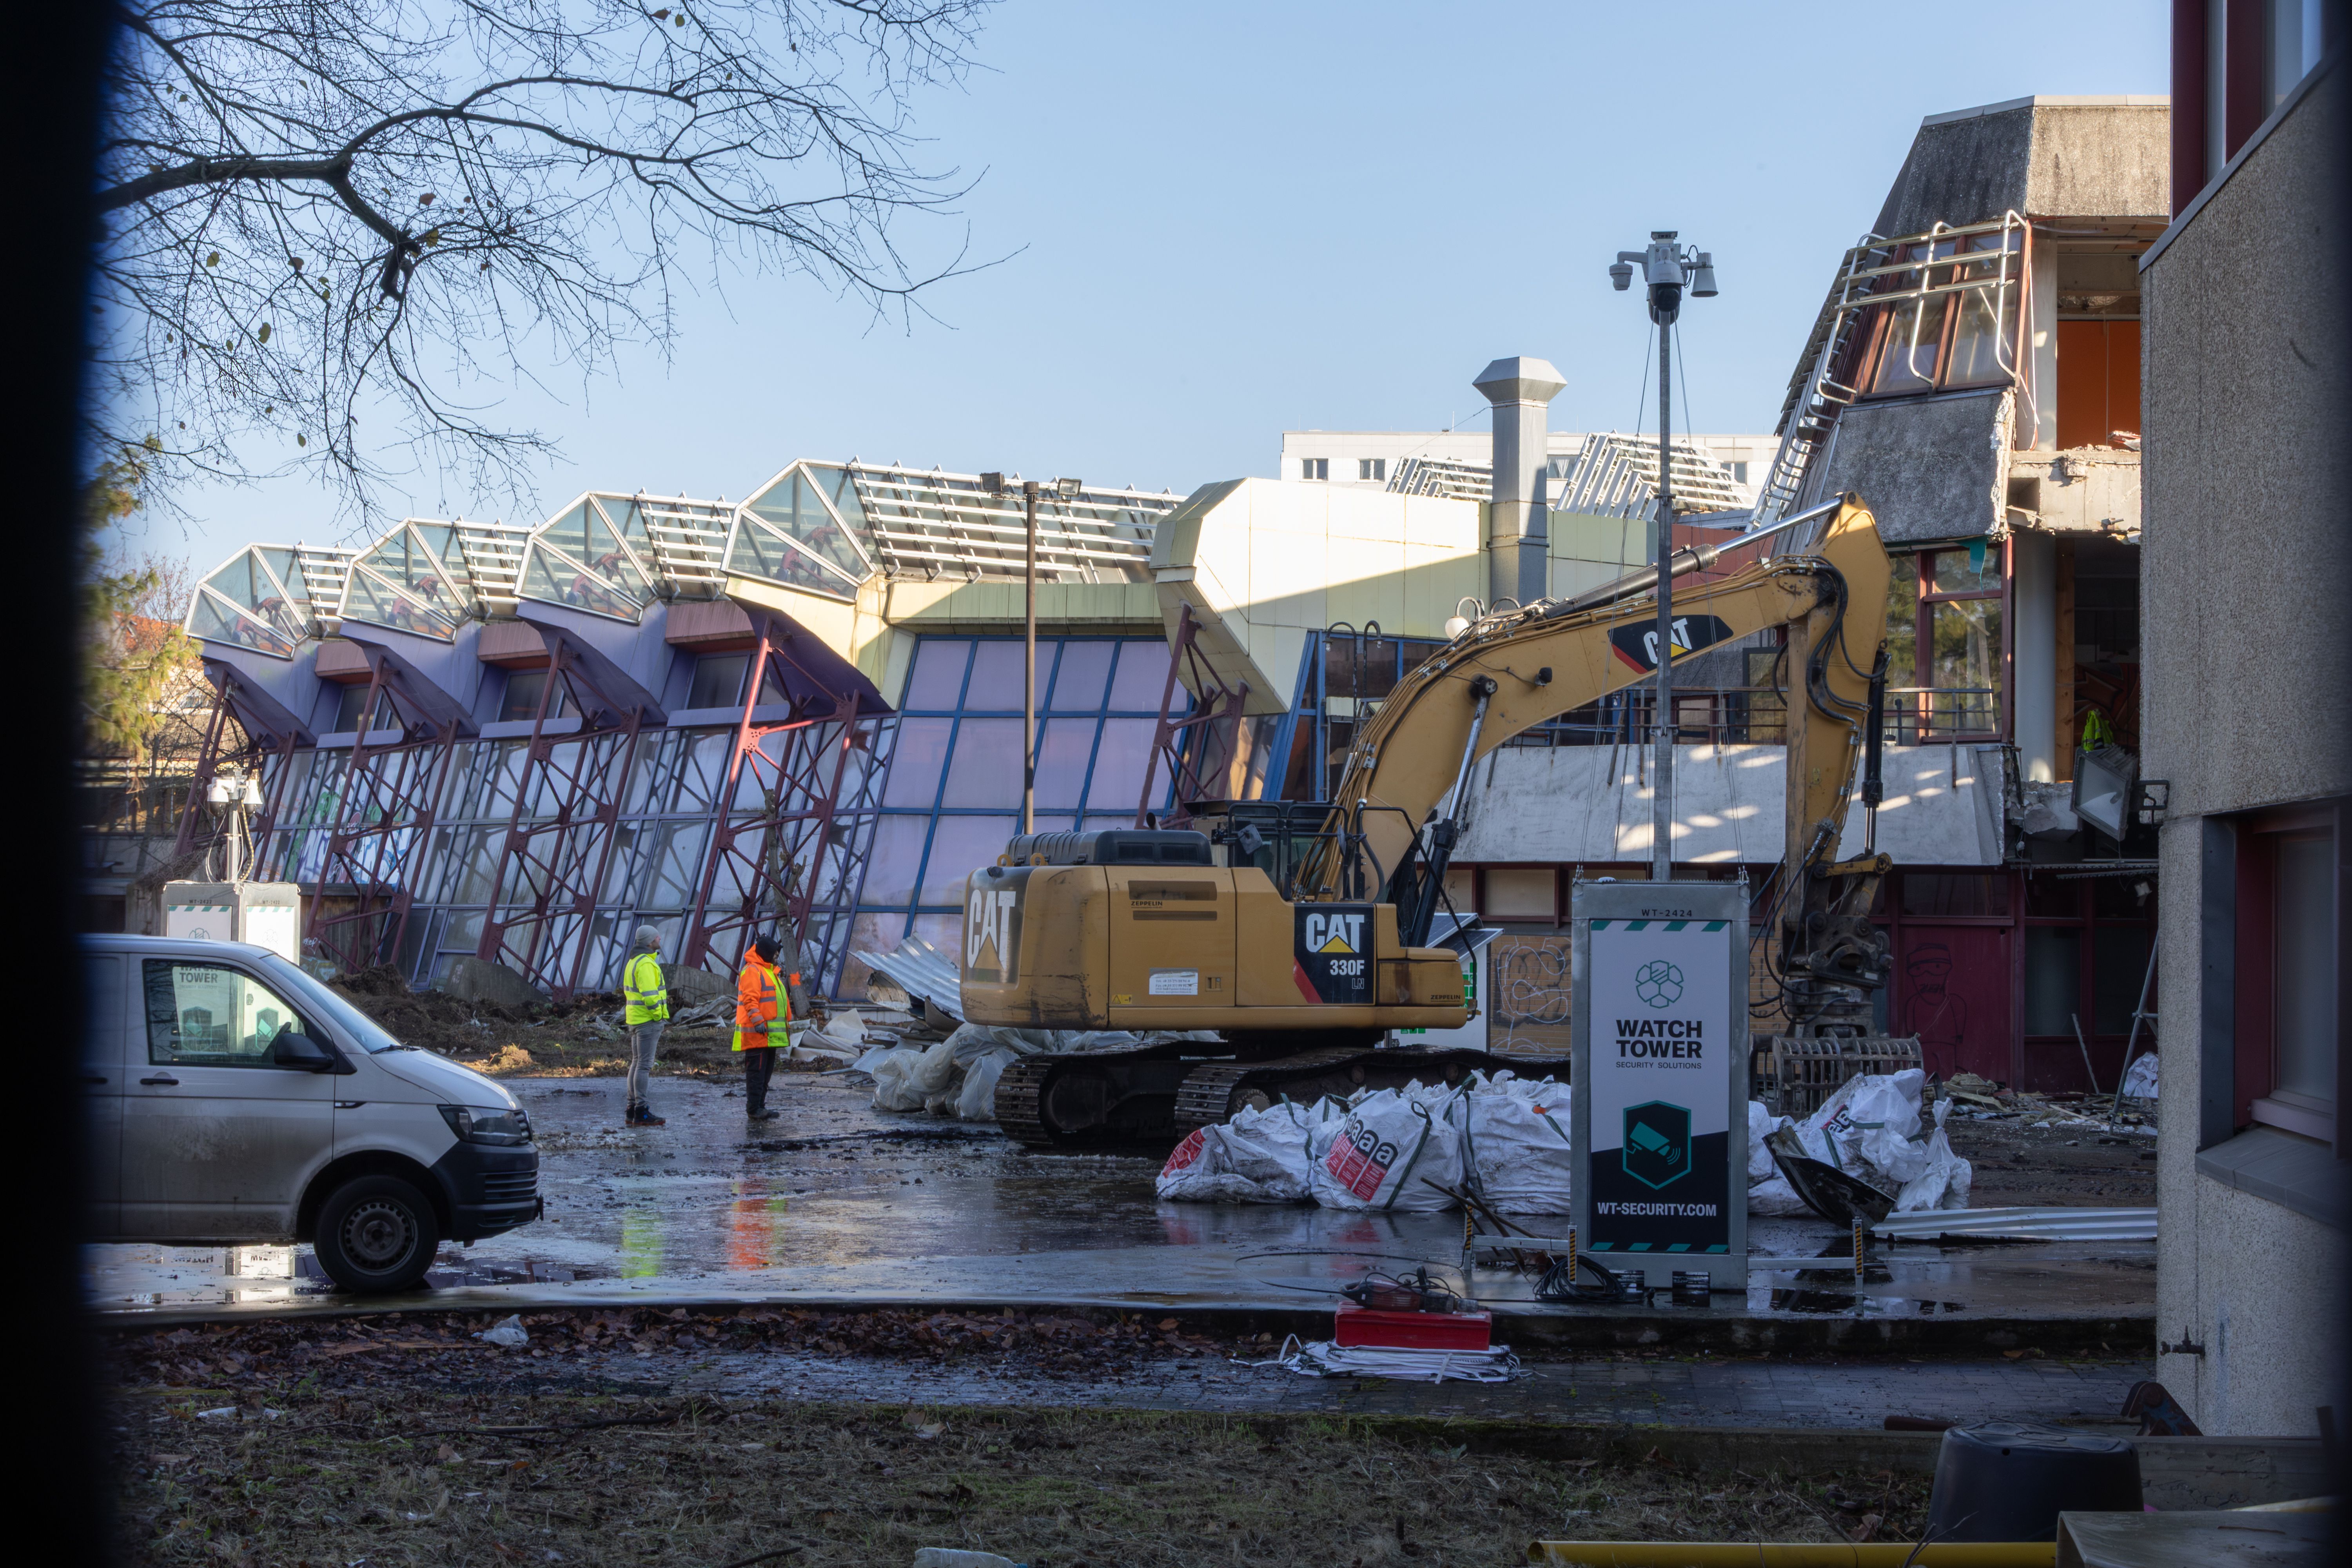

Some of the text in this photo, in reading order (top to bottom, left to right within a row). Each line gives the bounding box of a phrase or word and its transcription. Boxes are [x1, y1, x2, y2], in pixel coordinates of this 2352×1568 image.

[967, 889, 1016, 970] CAT
[1306, 913, 1365, 953] CAT
[1330, 960, 1365, 975] 330F
[180, 973, 218, 983] TOWER
[1352, 978, 1364, 989] LN
[1616, 1020, 1702, 1038] WATCH
[1616, 1040, 1702, 1058] TOWER
[1359, 1133, 1375, 1152] a
[1376, 1145, 1392, 1165] a
[1598, 1202, 1717, 1217] WT-SECURITY.COM
